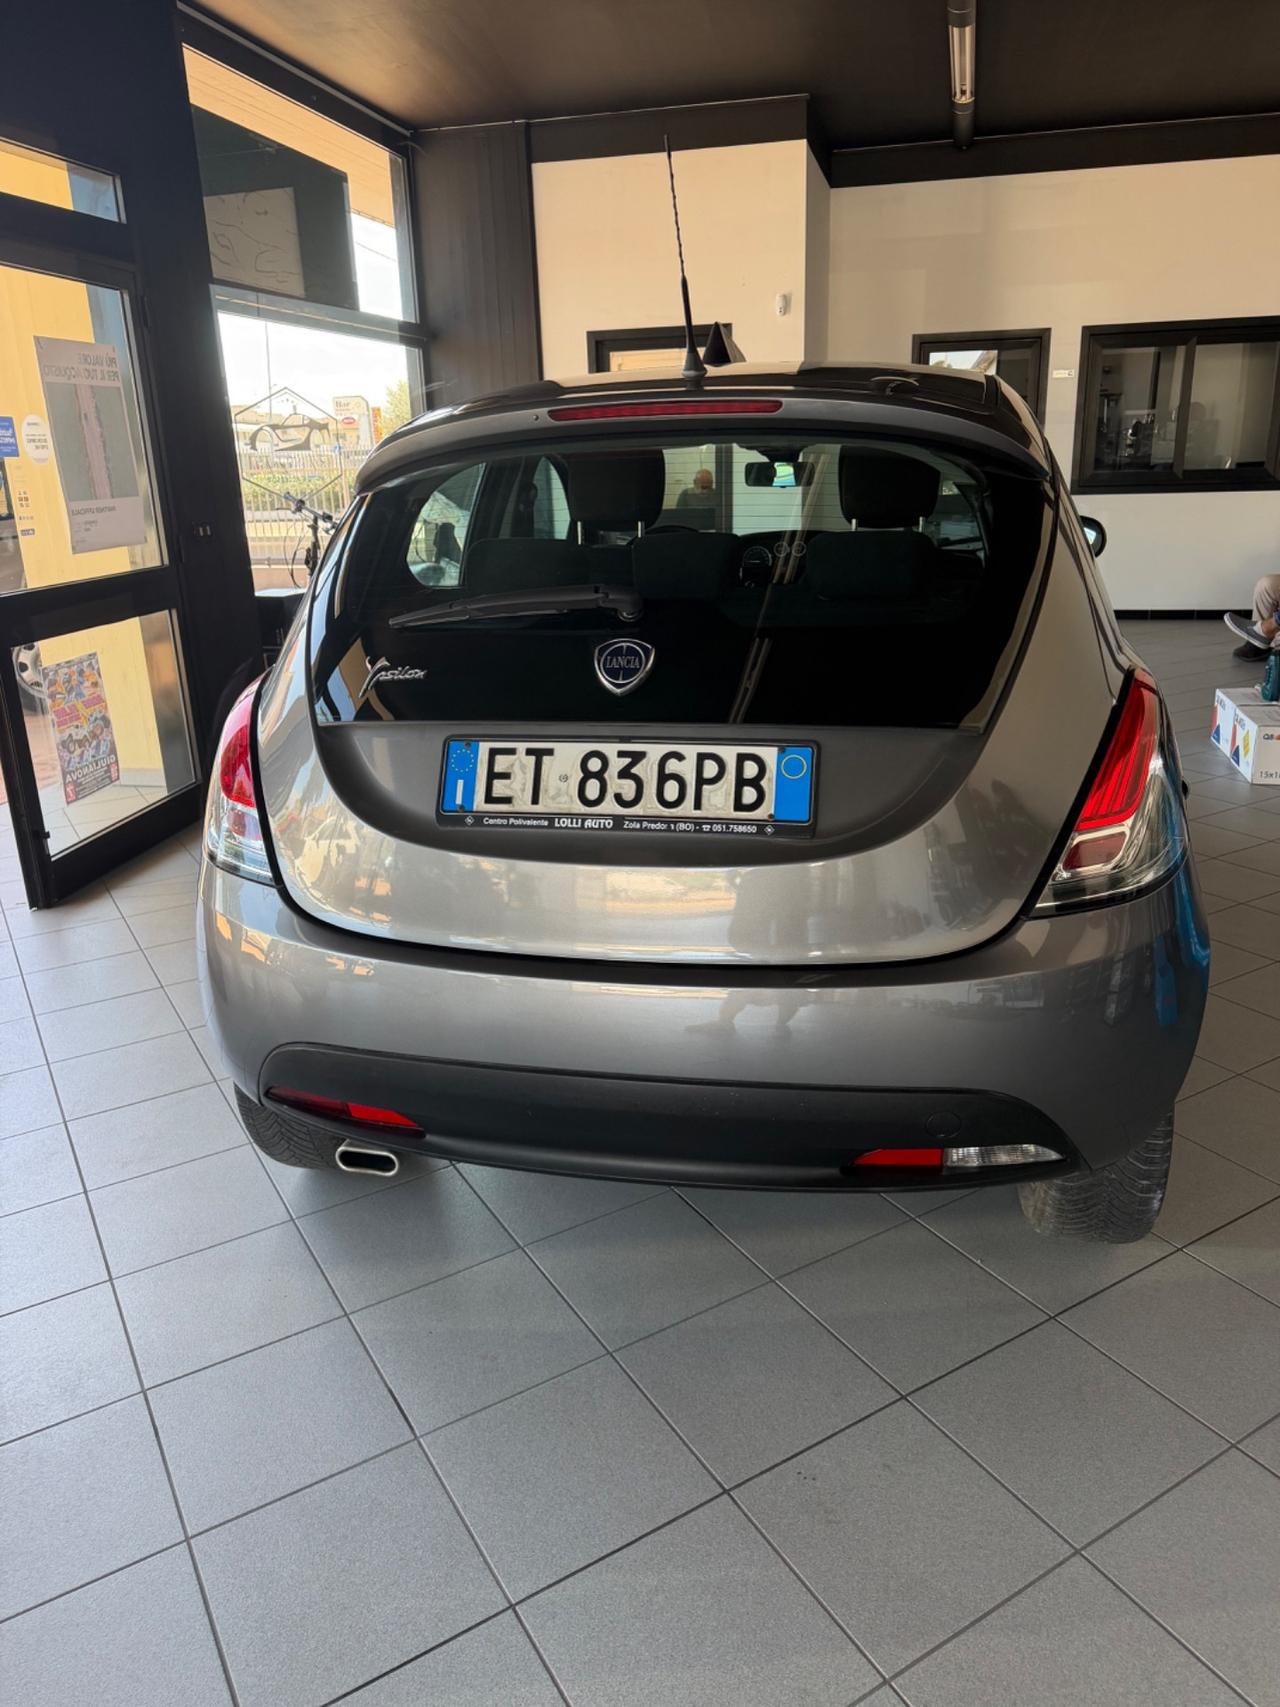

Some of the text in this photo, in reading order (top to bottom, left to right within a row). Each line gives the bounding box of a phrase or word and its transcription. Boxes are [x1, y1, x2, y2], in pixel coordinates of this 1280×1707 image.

[605, 656, 641, 669] LANCIA
[358, 655, 427, 698] Ypsilon
[483, 747, 767, 812] ET 836PB
[483, 817, 614, 829] Centro Polivalente LOLLI AUTO
[623, 821, 641, 830] Zola
[676, 823, 695, 832] (BO)
[712, 825, 758, 834] 051.758650
